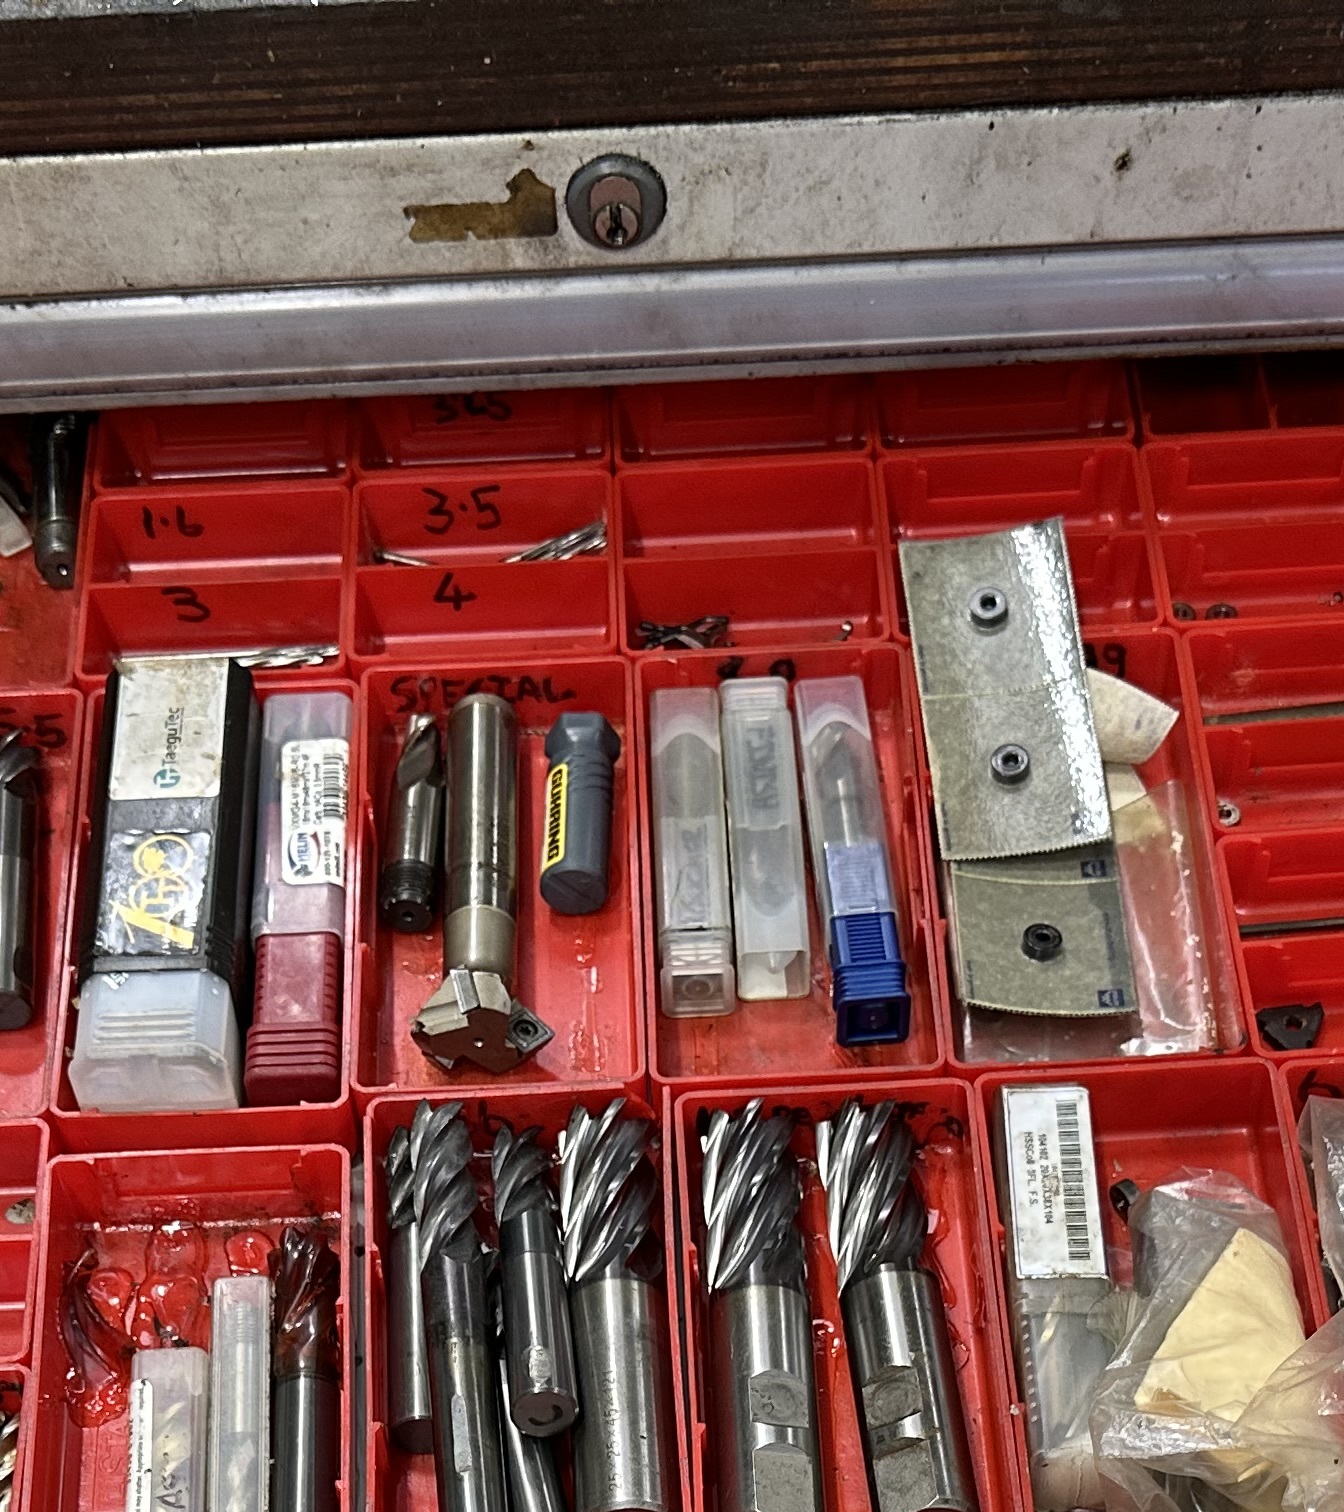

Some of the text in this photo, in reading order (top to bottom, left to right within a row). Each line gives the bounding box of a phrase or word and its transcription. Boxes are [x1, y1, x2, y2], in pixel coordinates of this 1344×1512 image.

[422, 485, 502, 535] 3.5
[162, 588, 211, 623] 3
[433, 571, 477, 612] 4
[160, 706, 184, 768] TaeguTec
[546, 767, 563, 862] GUHRING
